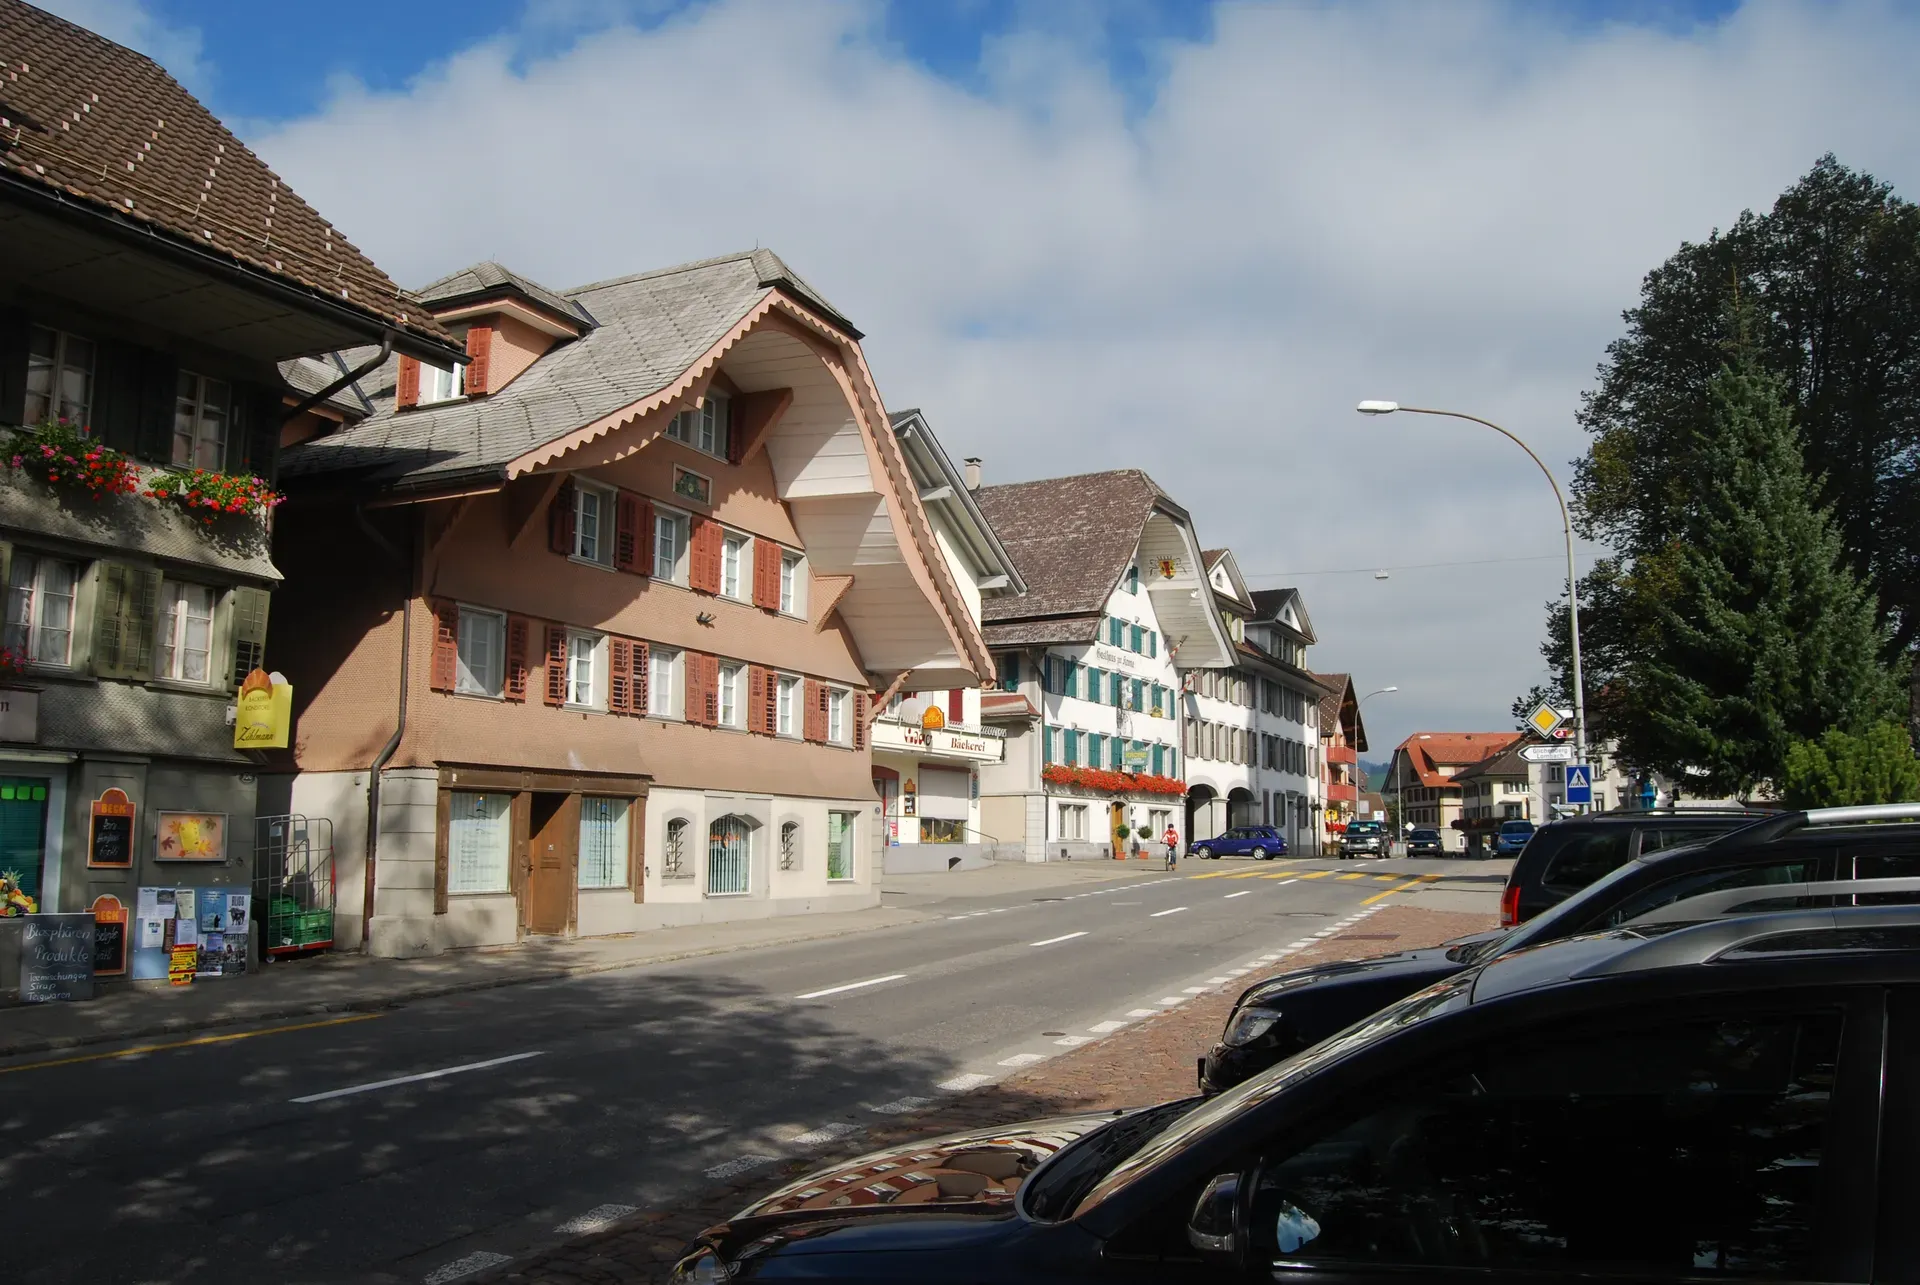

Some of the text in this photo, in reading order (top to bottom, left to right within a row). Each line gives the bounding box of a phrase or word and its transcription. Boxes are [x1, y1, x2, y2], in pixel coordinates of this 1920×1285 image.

[924, 715, 941, 724] BECK
[950, 737, 986, 752] Bäckerei
[101, 803, 127, 814] BECK
[34, 945, 89, 962] Produkte
[29, 982, 56, 991] Sirup
[27, 990, 71, 1001] Teigwaren
